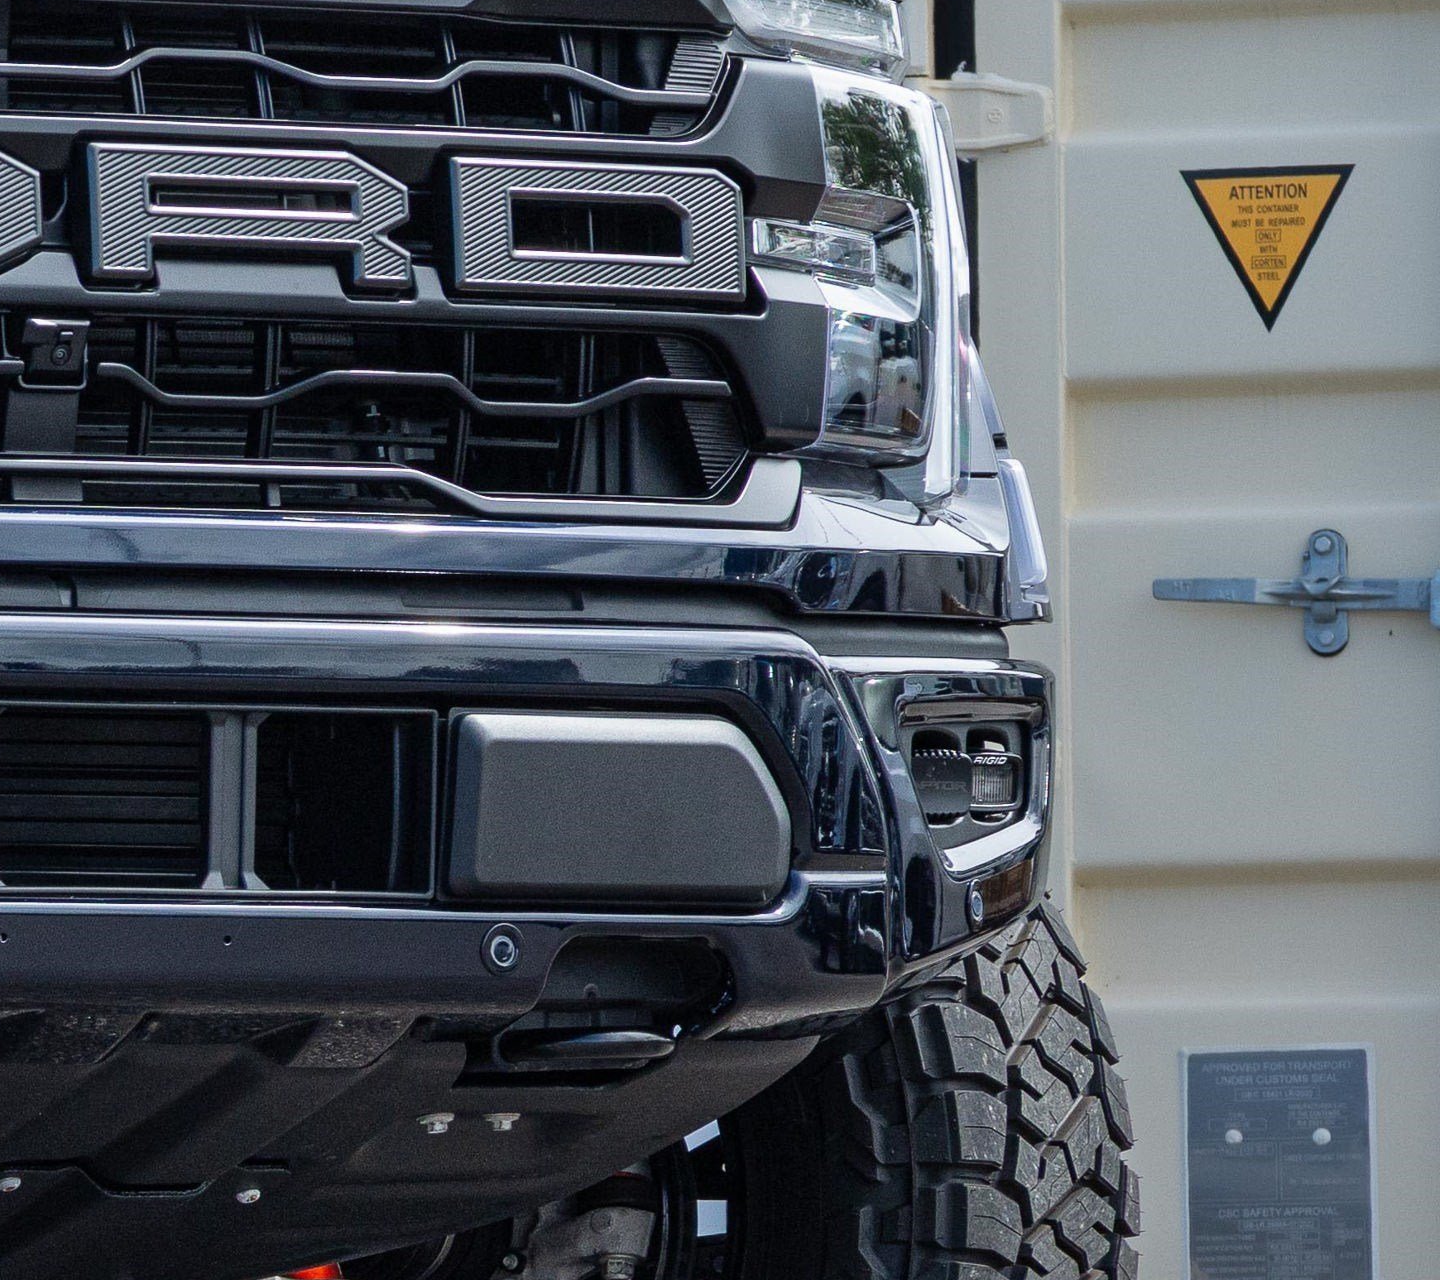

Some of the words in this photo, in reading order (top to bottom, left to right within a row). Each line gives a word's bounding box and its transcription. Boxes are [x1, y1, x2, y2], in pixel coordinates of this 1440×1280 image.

[1228, 182, 1308, 201] ATTENTION
[1237, 205, 1253, 214] THIS
[1256, 204, 1300, 215] CONTAINER
[1231, 219, 1251, 228] MUST
[1255, 218, 1265, 227] BE
[1268, 217, 1306, 227] REPAIRED
[1258, 231, 1278, 241] ONLY
[1259, 245, 1278, 254] WITH
[1253, 258, 1285, 268] CORTEN
[1257, 272, 1280, 281] STEEL
[973, 756, 1008, 766] RIGID
